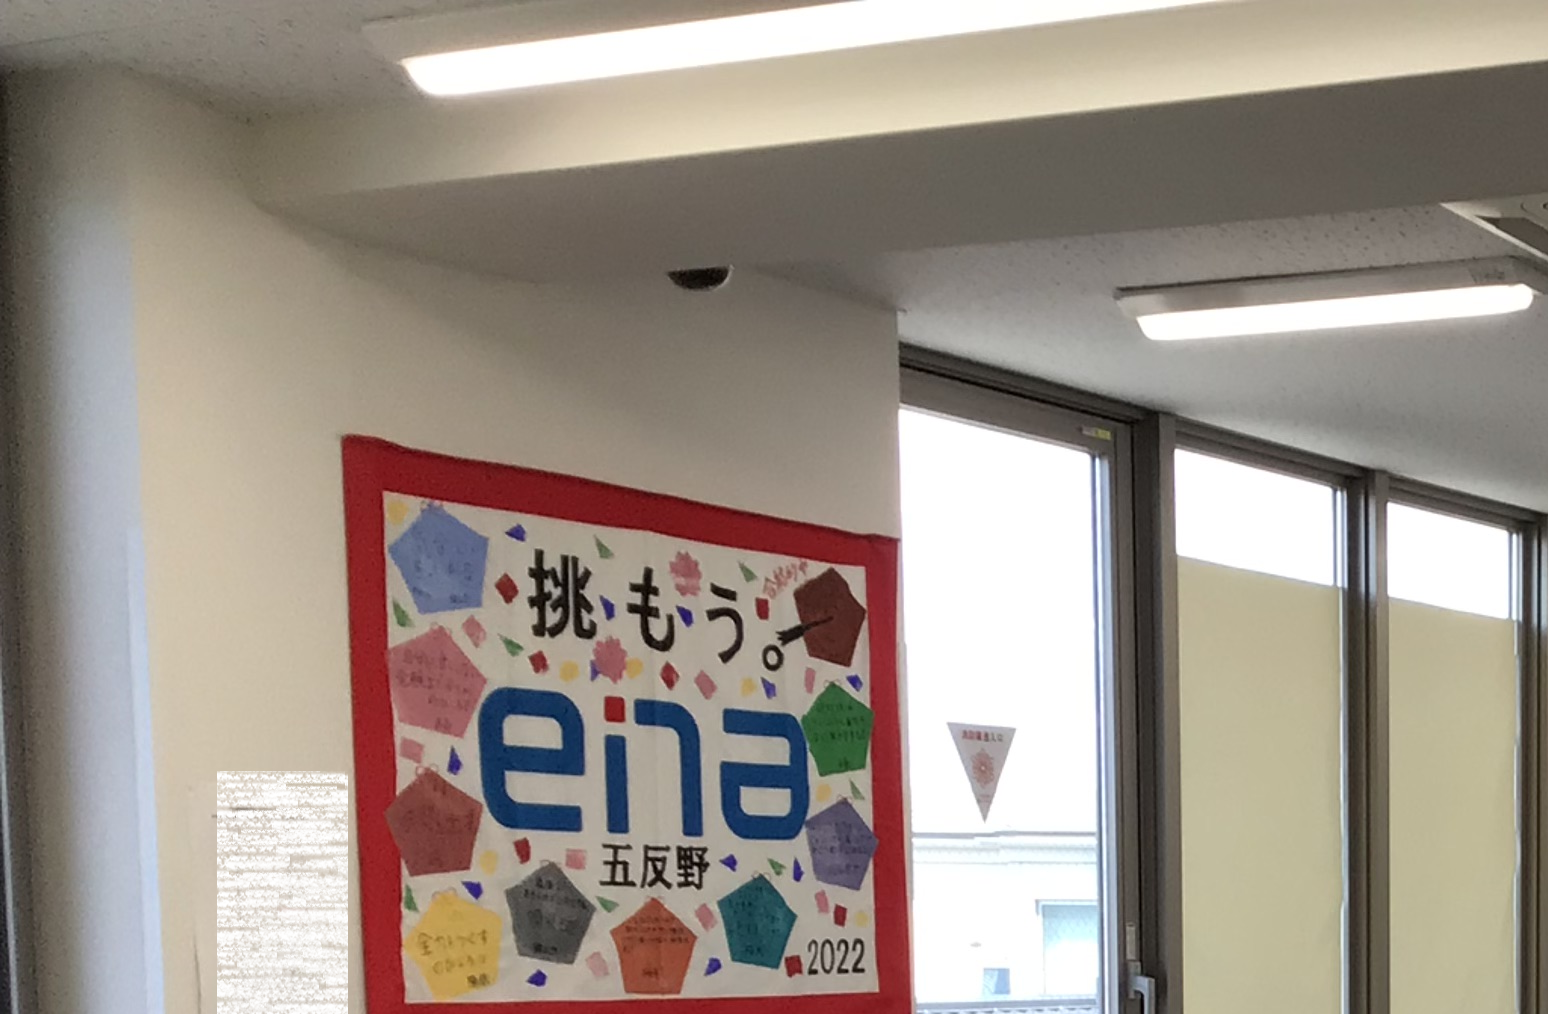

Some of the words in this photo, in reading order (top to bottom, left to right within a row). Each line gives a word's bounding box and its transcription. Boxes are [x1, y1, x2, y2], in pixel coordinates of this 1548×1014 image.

[527, 548, 785, 672] 挑もう。
[478, 686, 810, 840] ena
[599, 844, 710, 890] 五反野
[807, 937, 866, 976] 2022
